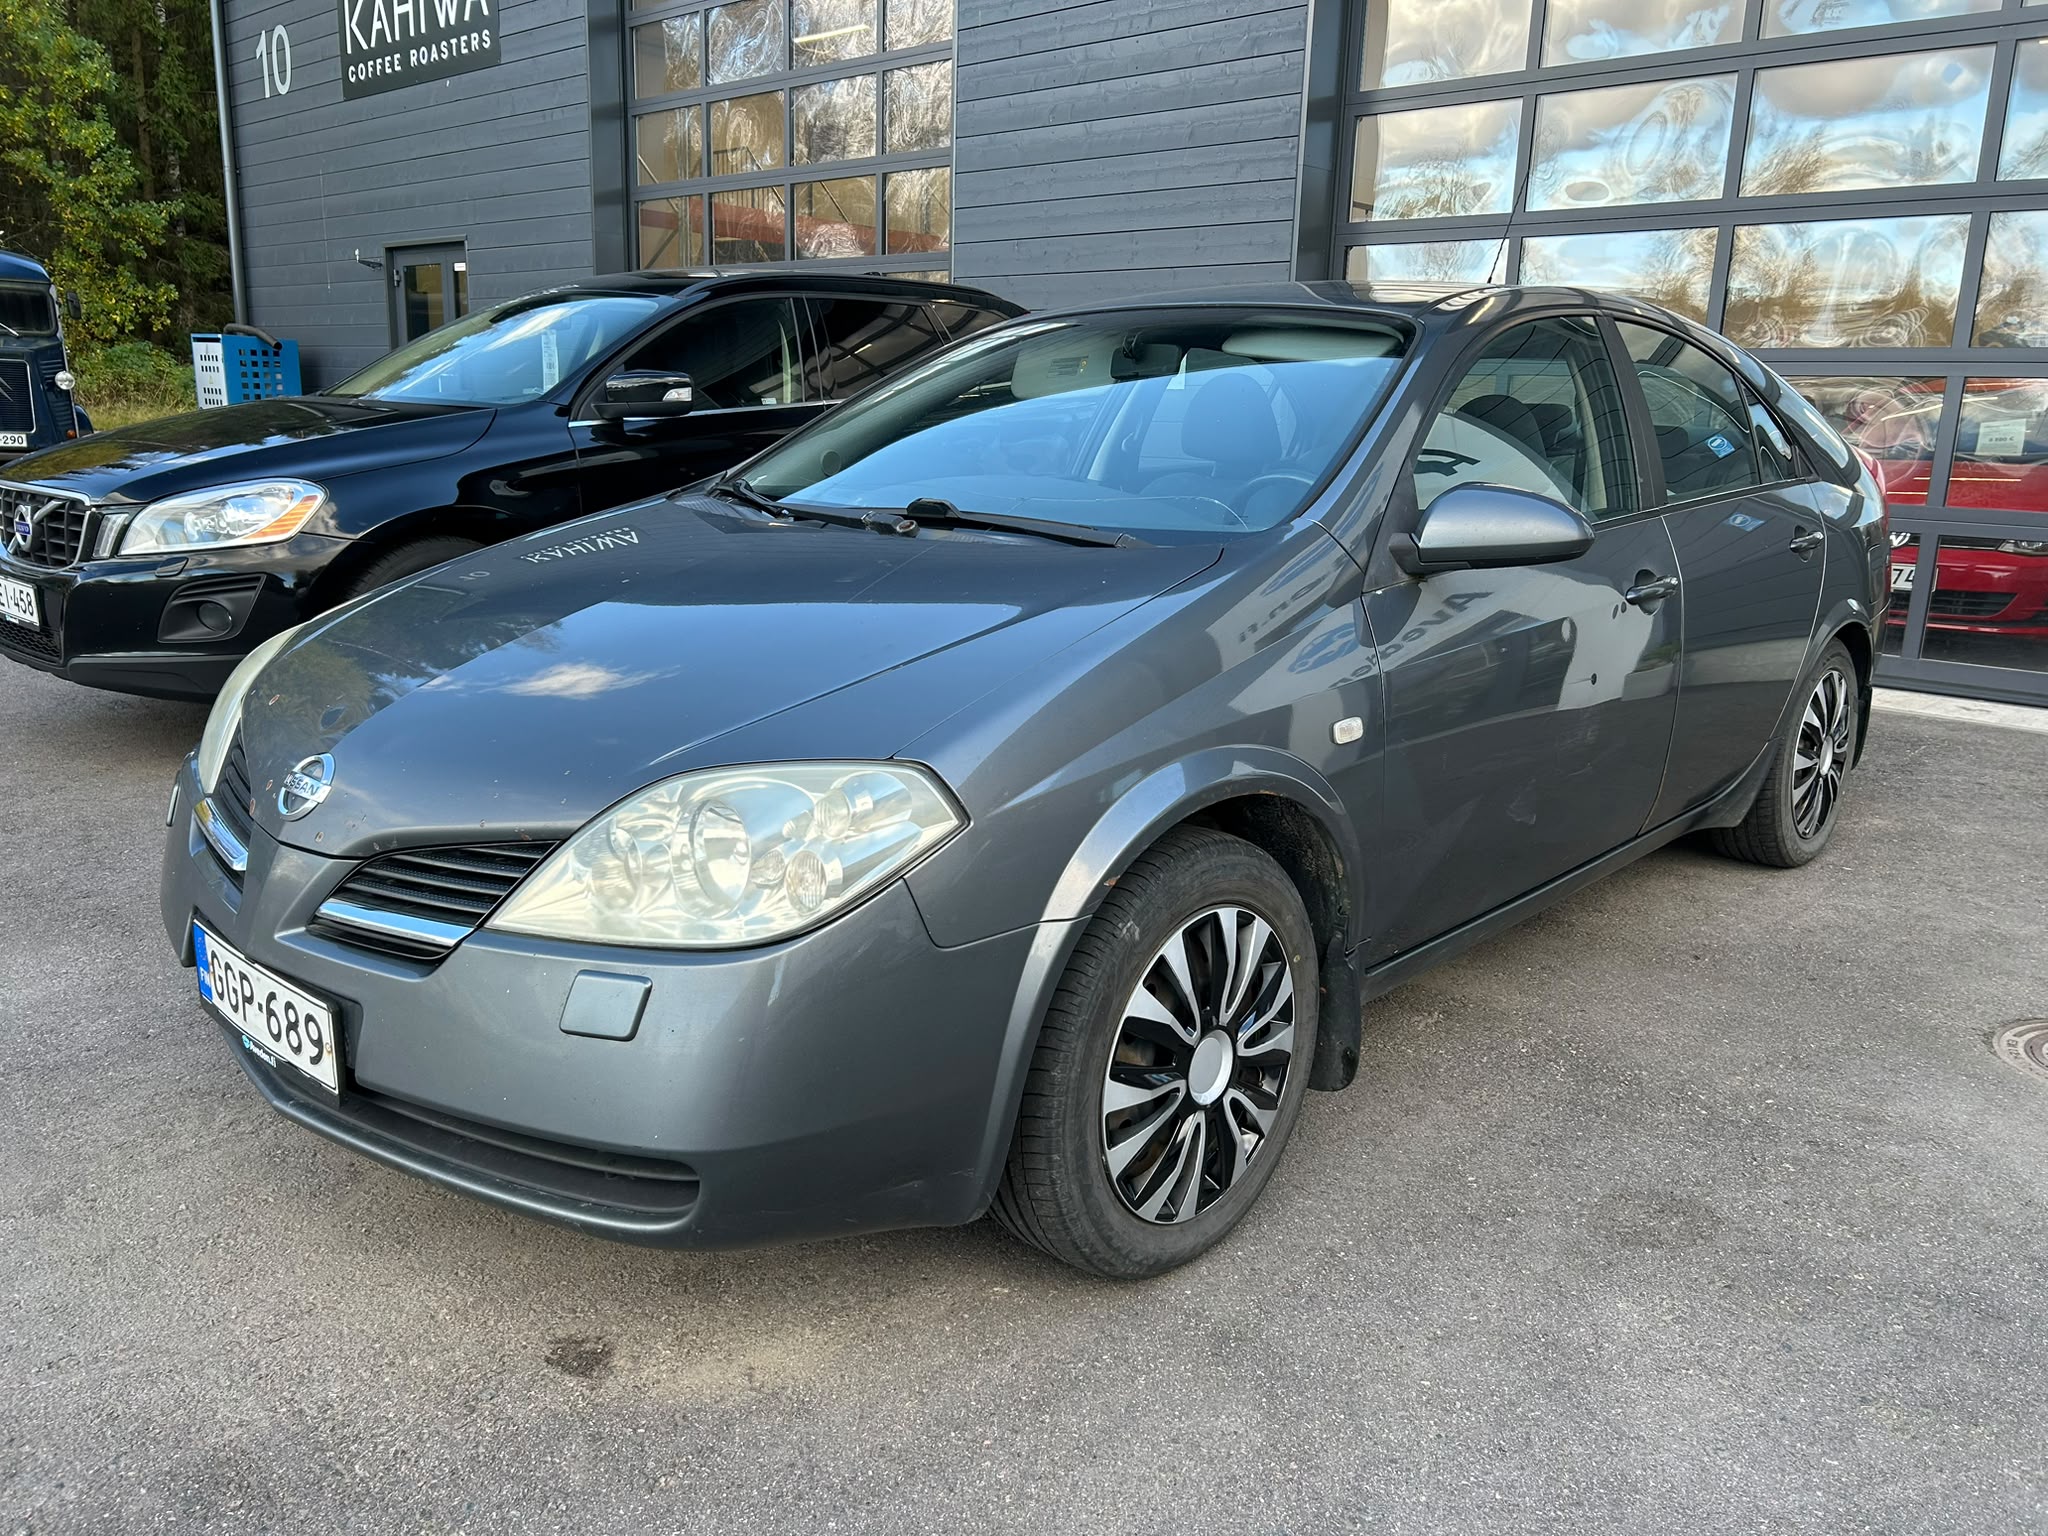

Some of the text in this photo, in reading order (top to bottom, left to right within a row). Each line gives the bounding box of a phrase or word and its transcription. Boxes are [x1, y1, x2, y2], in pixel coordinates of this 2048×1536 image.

[255, 24, 292, 99] 10
[348, 29, 491, 83] COFFEE ROASTERS
[211, 949, 325, 1066] GGP-689
